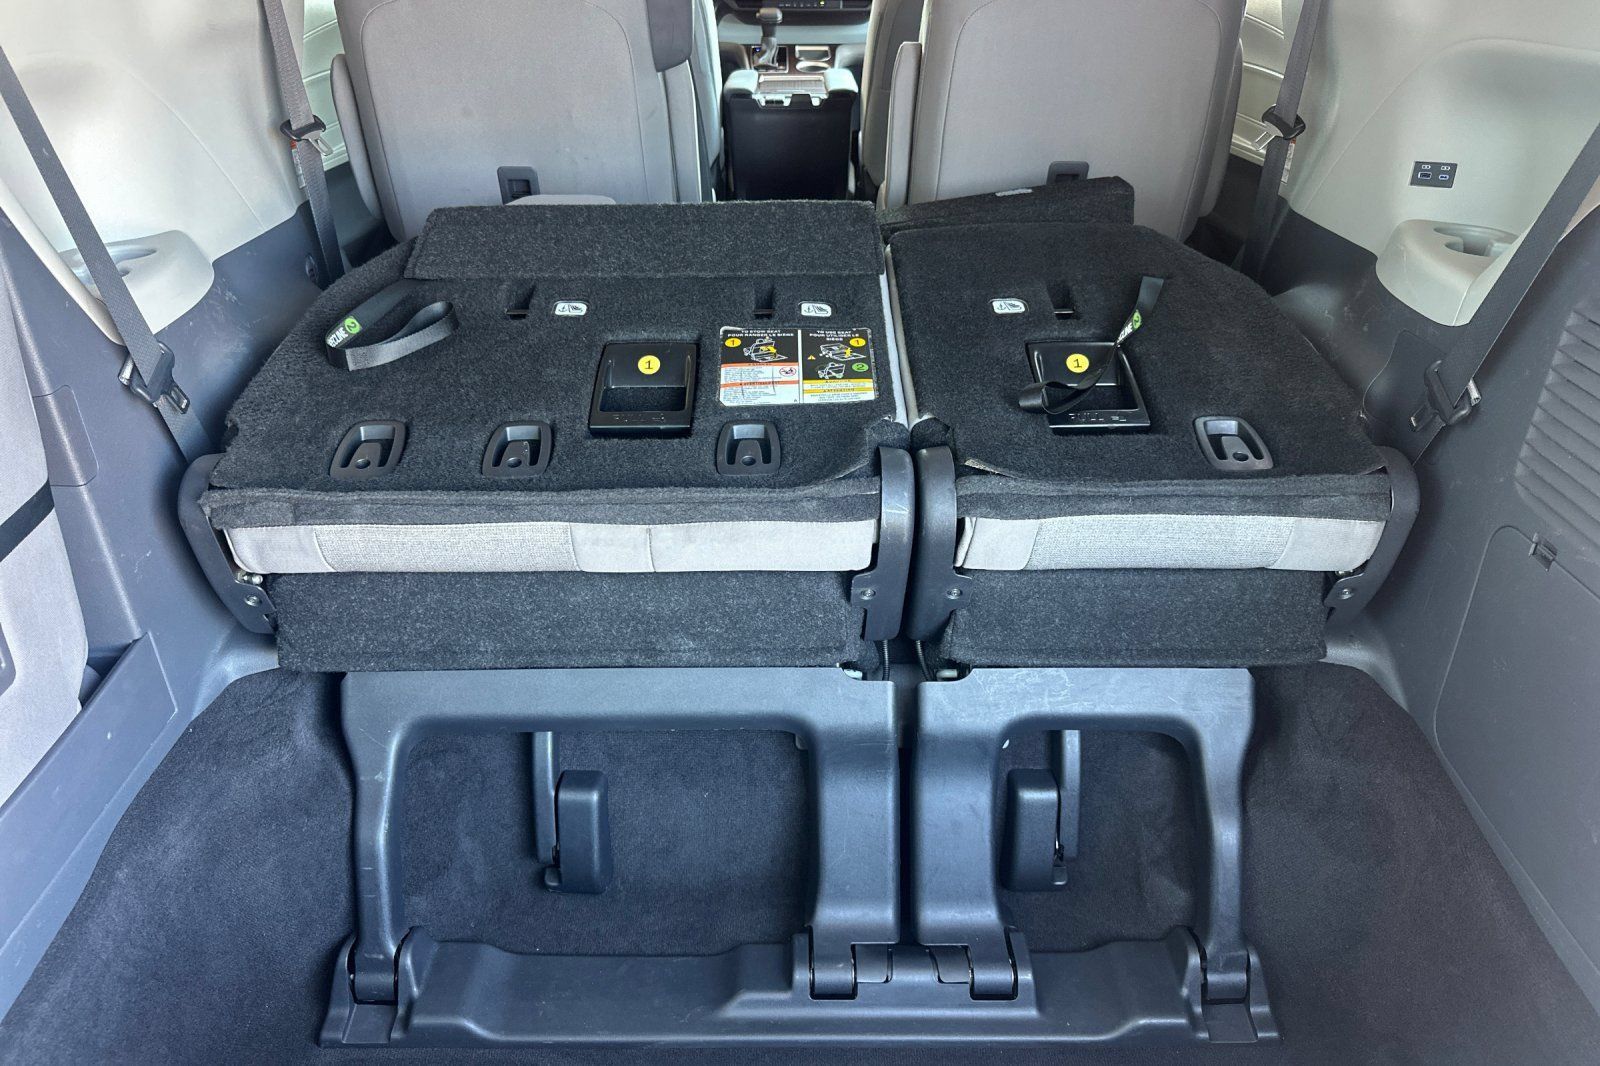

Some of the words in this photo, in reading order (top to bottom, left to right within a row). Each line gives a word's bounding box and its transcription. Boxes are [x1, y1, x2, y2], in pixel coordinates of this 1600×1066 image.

[347, 321, 357, 331] 2
[645, 360, 653, 370] 1
[1073, 359, 1082, 368] 1
